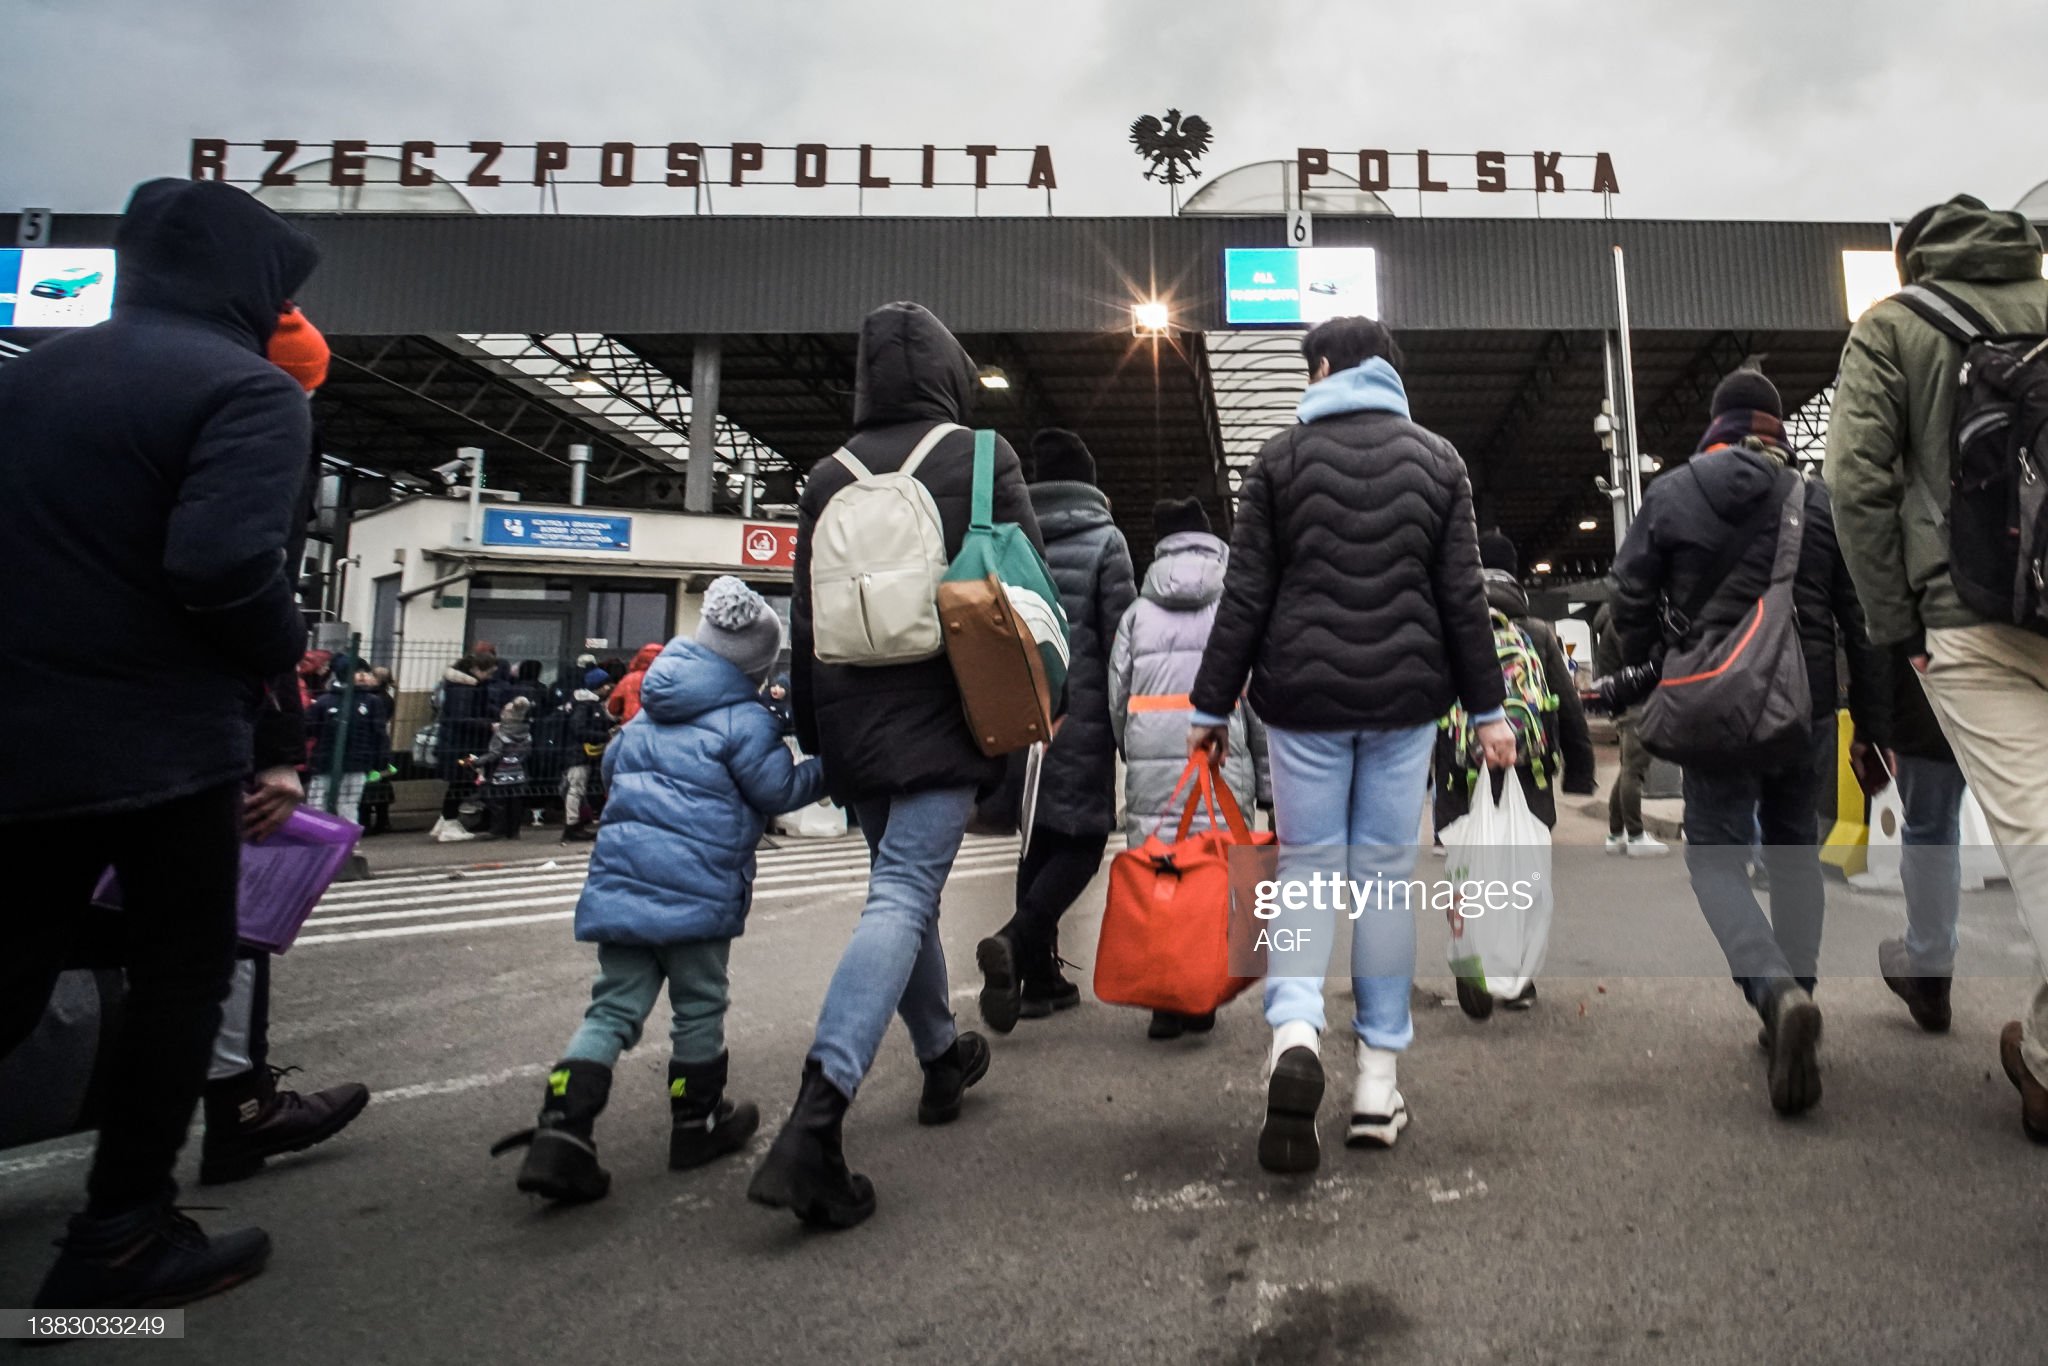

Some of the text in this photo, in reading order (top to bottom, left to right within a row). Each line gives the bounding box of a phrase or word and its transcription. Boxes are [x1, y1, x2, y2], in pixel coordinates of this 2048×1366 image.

[191, 138, 1620, 193] RZECZPOSPOLITA POLSKA
[24, 212, 42, 240] 5
[1293, 215, 1306, 242] 6
